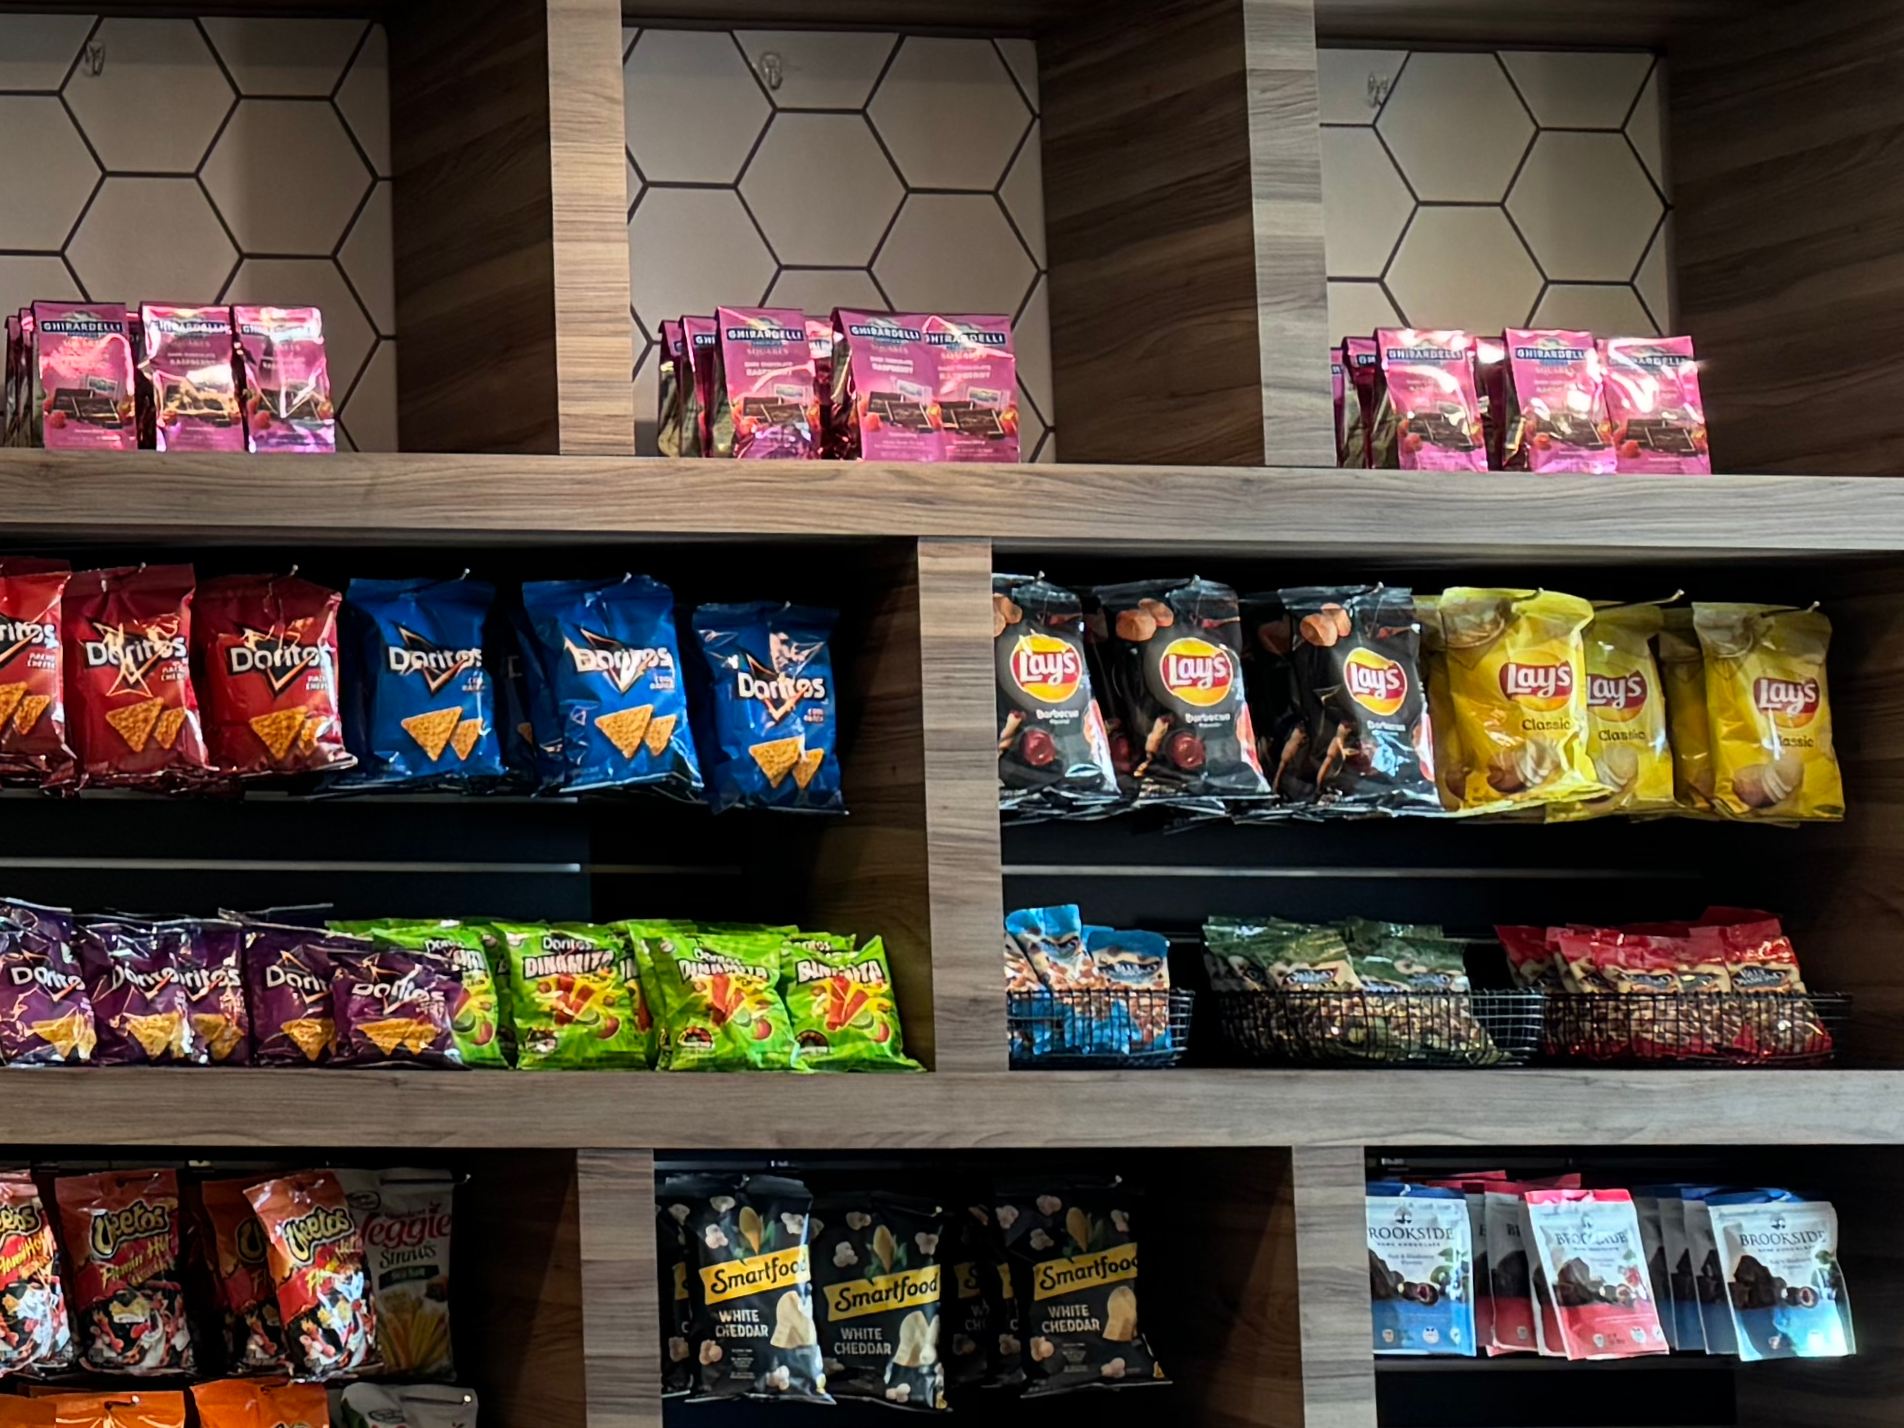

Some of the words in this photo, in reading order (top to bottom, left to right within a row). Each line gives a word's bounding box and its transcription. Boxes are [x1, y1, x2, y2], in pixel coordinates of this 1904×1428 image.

[40, 321, 123, 335] GHIRARDELLI
[726, 328, 804, 342] GHIRARDELLI
[850, 325, 922, 342] GHIRARDELLI
[85, 635, 187, 668] Doritos
[388, 645, 483, 674] Doritos
[576, 645, 672, 673] Doritos
[1019, 646, 1078, 685] Lay's
[1167, 650, 1230, 690] Lay's
[738, 672, 826, 701] Doritos
[1350, 665, 1400, 700] Lay's
[1506, 660, 1572, 699] Lay's
[1586, 671, 1642, 710] Lay's
[1758, 678, 1817, 715] Lay's
[1522, 718, 1571, 732] Classic
[1598, 729, 1646, 742] Classic
[542, 937, 593, 951] Doritos
[285, 1207, 352, 1262] Cheetos
[1368, 1225, 1455, 1241] ROOKSIDE
[1739, 1229, 1827, 1248] BROOKSIDE
[711, 1254, 808, 1295] Smartfood
[834, 1272, 938, 1313] Smartfood
[719, 1310, 759, 1323] WHITE
[1048, 1304, 1090, 1318] WHITE
[715, 1324, 769, 1339] CHEDDAR
[841, 1328, 882, 1341] WHITE
[1042, 1318, 1100, 1334] CHEDDAR
[834, 1342, 892, 1356] CHEDDAR
